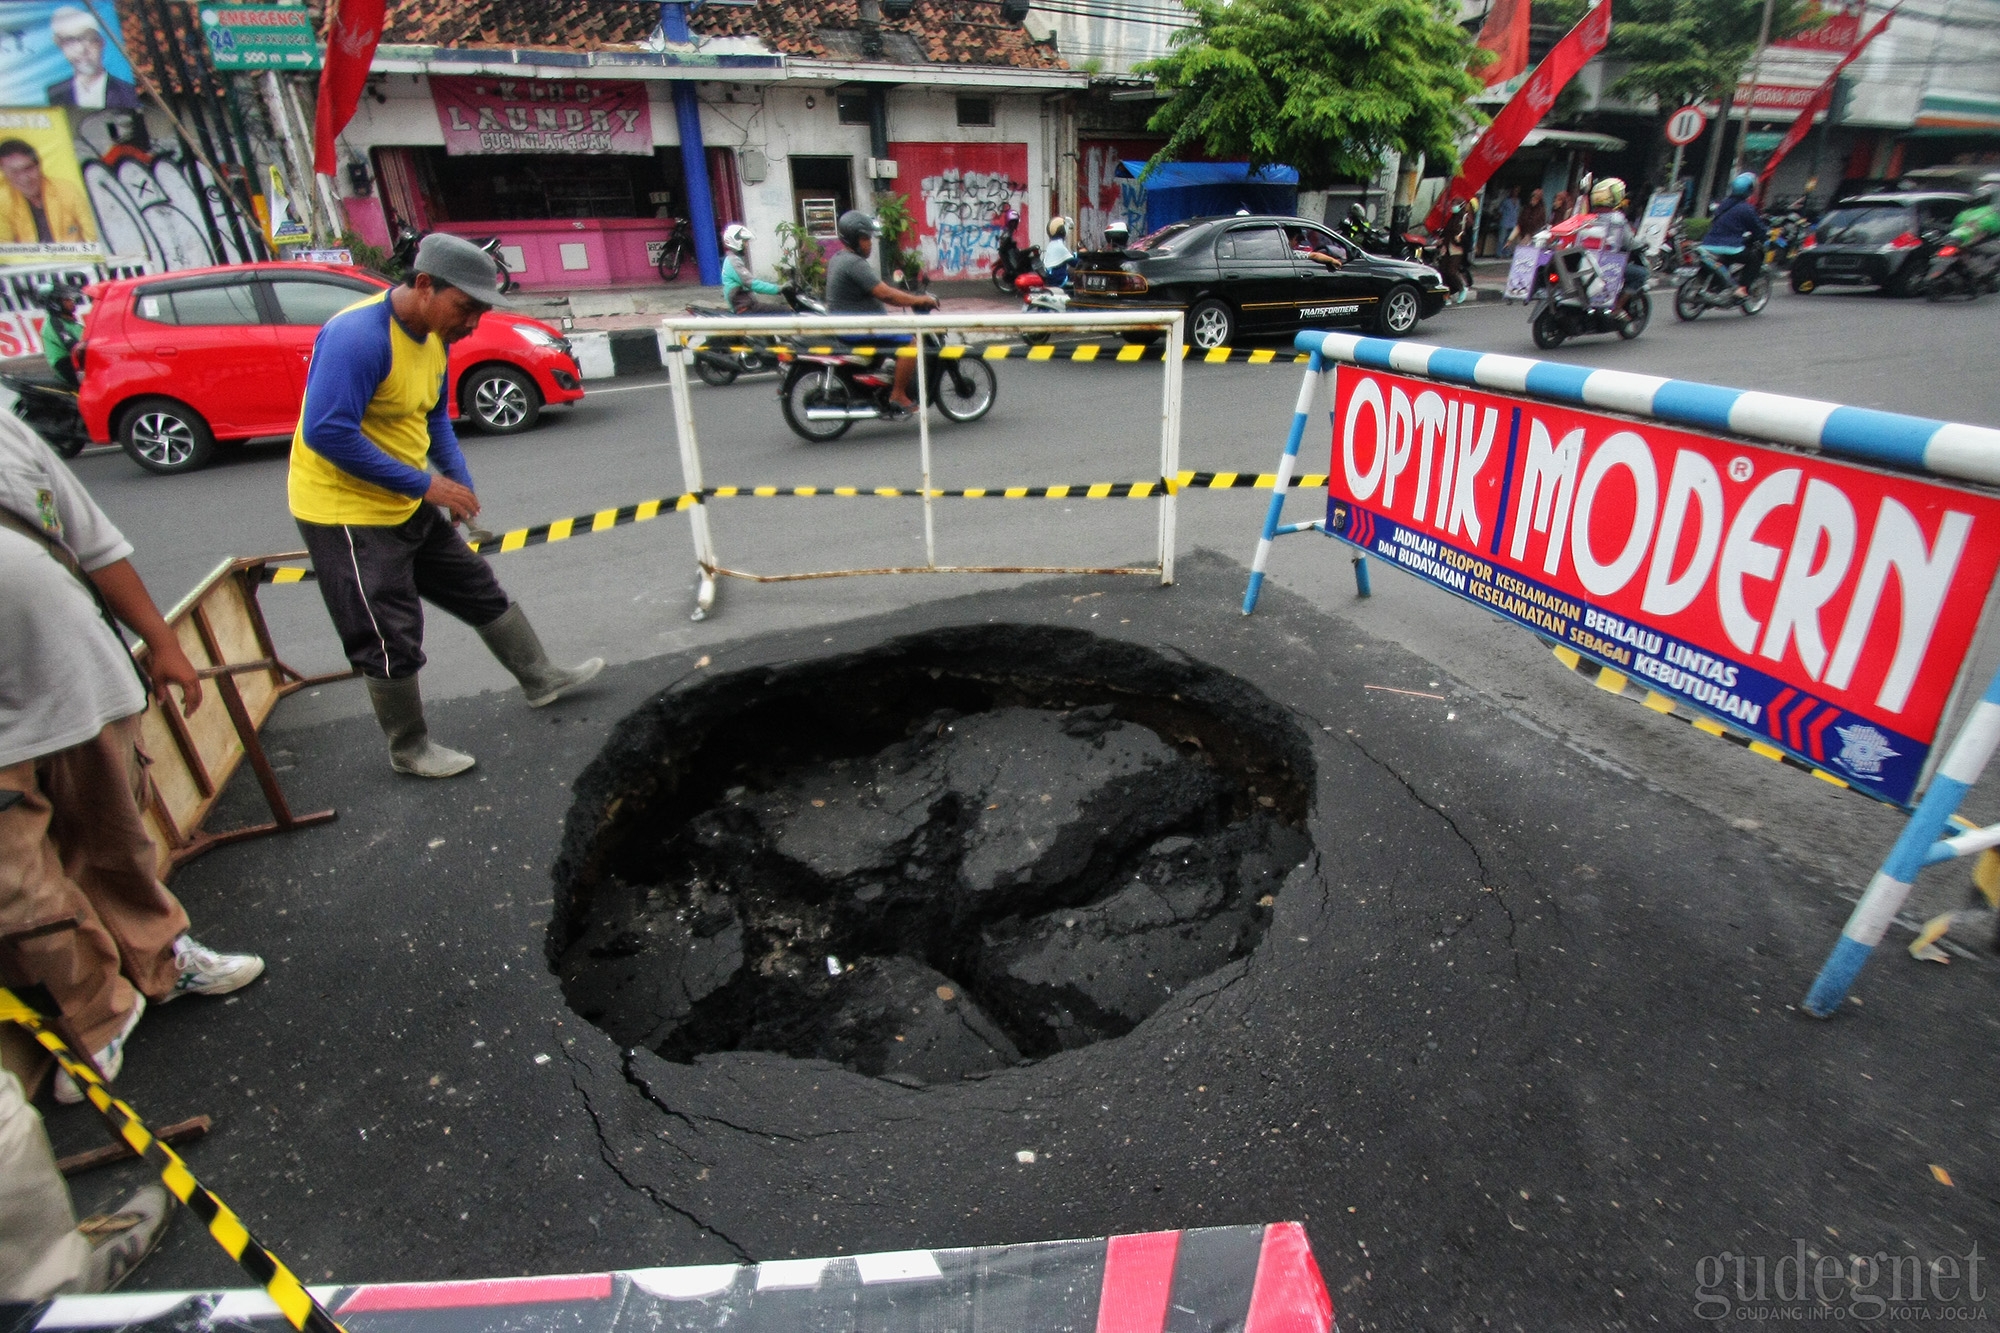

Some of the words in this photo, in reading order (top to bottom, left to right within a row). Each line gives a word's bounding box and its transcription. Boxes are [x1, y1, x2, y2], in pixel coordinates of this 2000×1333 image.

[217, 9, 306, 27] EMERGENCY
[207, 28, 236, 51] 24
[447, 106, 640, 133] LAUNDRY
[479, 132, 515, 150] CUCI
[518, 133, 565, 150] KILAT
[567, 134, 578, 150] 4
[580, 133, 613, 150] JAM
[1300, 305, 1359, 319] TRANSFORMERS
[1343, 377, 1499, 547] OPTIK
[1510, 417, 1975, 714] MODERN
[1392, 527, 1437, 558] JADILAH
[1439, 545, 1493, 582] PELOPOR
[1495, 572, 1581, 622] KESELAMATAN
[1584, 608, 1663, 655] BERLALU
[1664, 641, 1740, 687] LINTAS
[1378, 539, 1397, 558] DAN
[1398, 547, 1466, 591] BUDAYAKAN
[1468, 578, 1566, 636] KESELAMATAN
[1569, 626, 1631, 665] SEBAGAI
[1633, 653, 1763, 725] KEBUTUHAN
